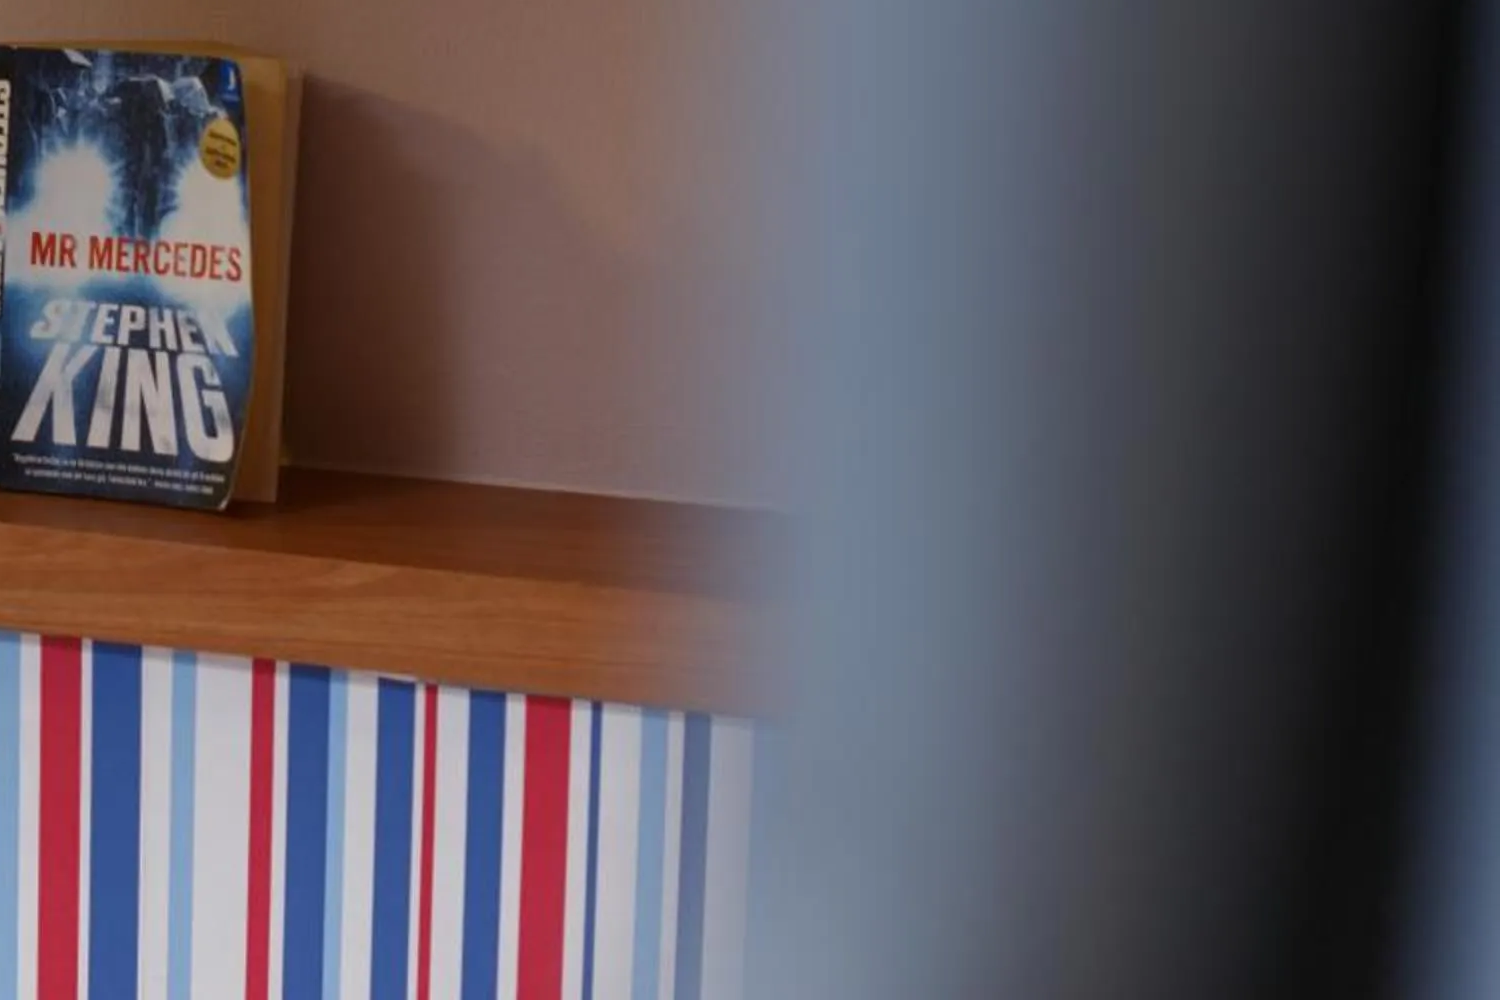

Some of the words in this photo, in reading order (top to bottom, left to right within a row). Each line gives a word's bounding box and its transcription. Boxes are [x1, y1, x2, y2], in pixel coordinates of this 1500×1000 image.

[30, 231, 77, 269] MR
[88, 235, 243, 283] MERCEDES
[30, 301, 240, 358] STEPHEN
[10, 342, 235, 463] KING
